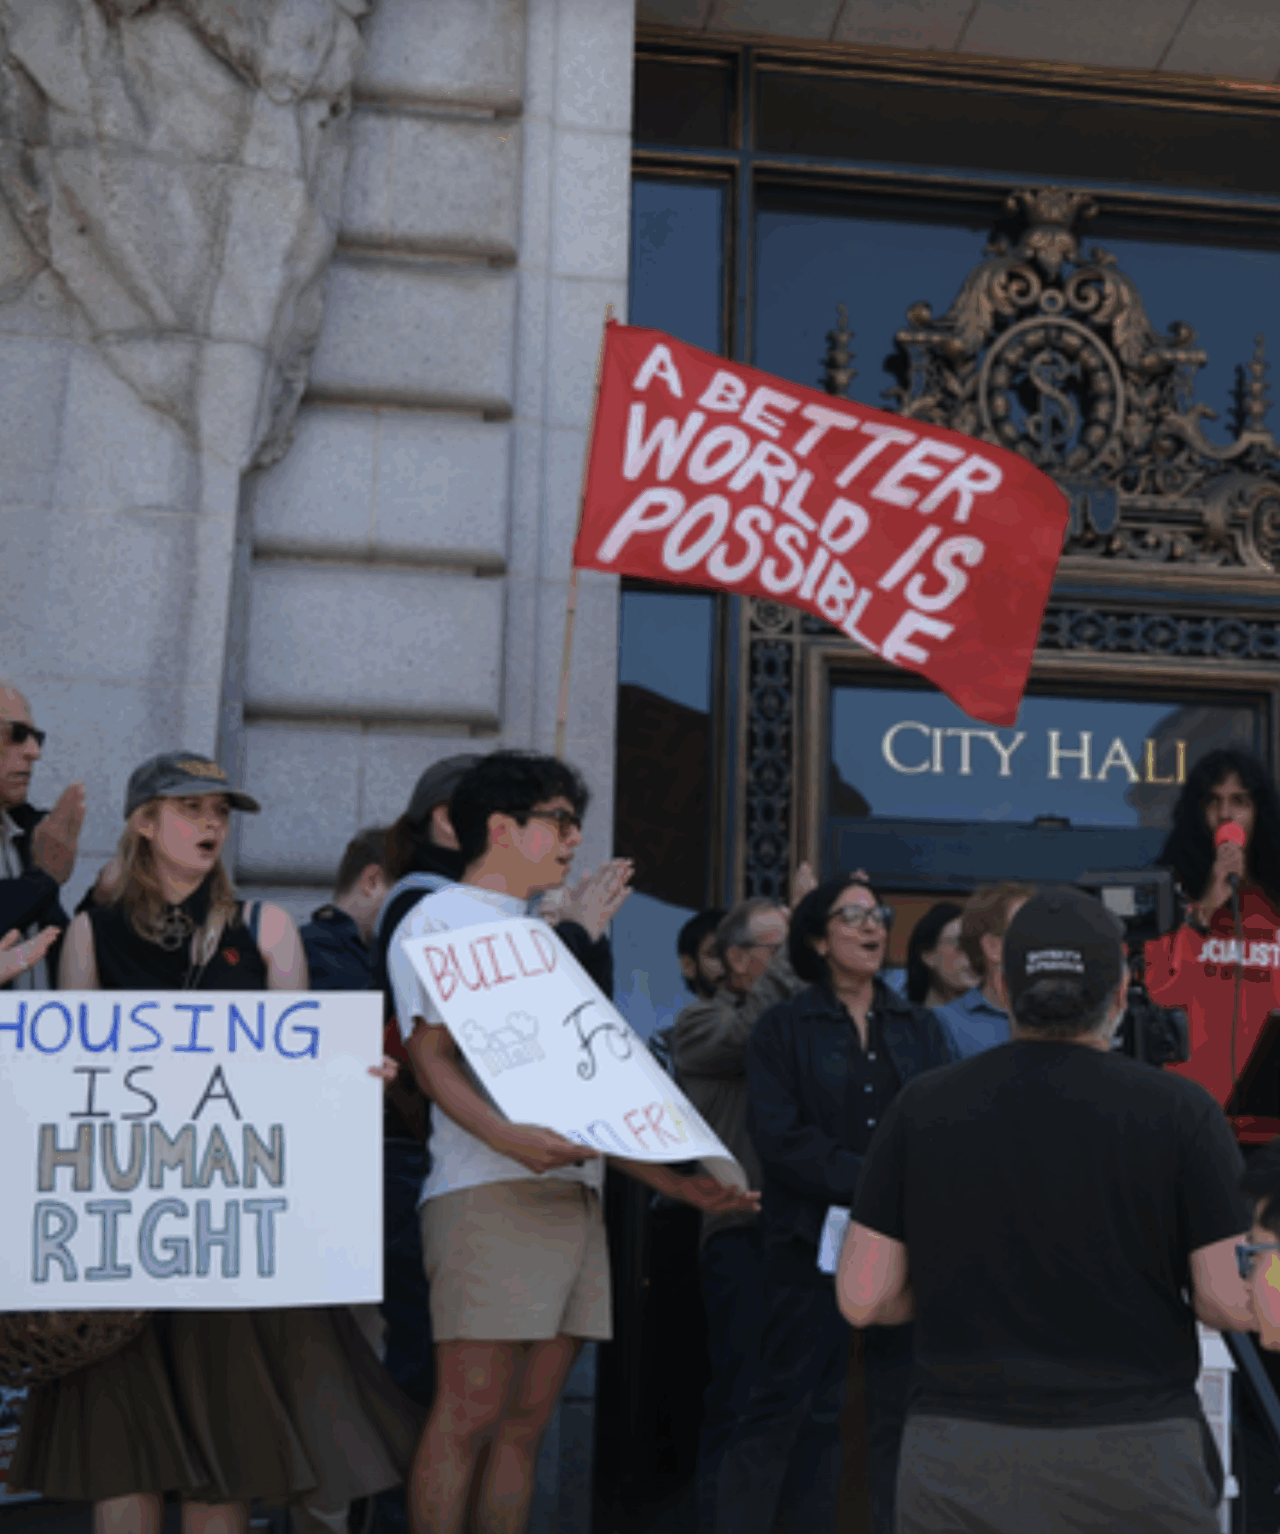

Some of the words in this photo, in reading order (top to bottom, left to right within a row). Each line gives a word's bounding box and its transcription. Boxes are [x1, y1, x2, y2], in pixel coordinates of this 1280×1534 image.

[632, 343, 683, 398] A
[697, 368, 1003, 522] BETTER
[621, 401, 870, 555] WORLD
[877, 524, 985, 613] IS
[596, 486, 955, 665] POSSIBLE
[881, 719, 1027, 777] CITY
[422, 927, 558, 1001] BUILD
[0, 1000, 321, 1059] HOUSING
[69, 1064, 157, 1120] IS
[191, 1063, 242, 1121] A
[37, 1121, 285, 1193] HUMAN
[31, 1198, 288, 1284] RIGHT
